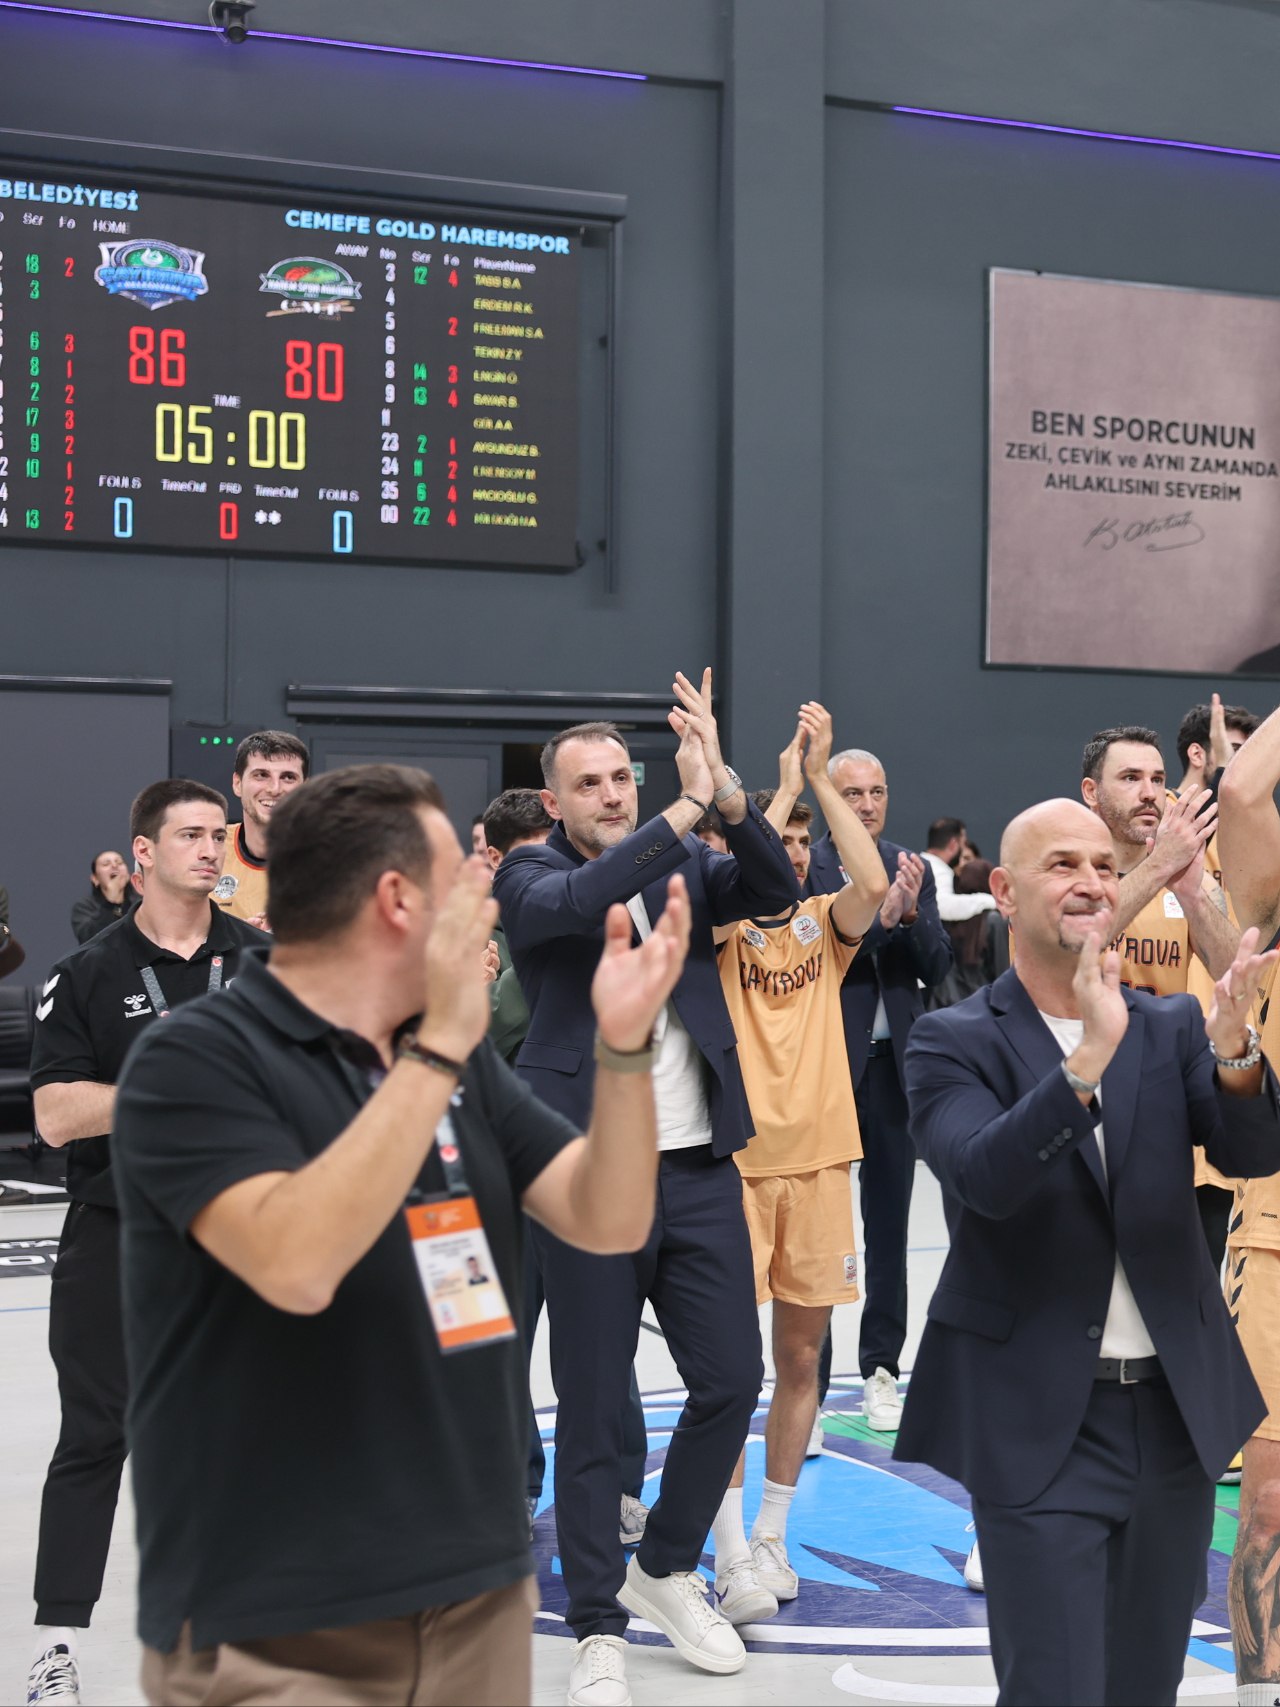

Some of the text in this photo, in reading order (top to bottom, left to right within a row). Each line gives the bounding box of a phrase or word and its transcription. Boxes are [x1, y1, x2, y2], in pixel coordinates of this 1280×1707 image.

[0, 179, 139, 212] BELEDİYESİ
[285, 209, 570, 255] CEMEFE GOLD HAREMSPOR
[26, 254, 40, 274] 18
[64, 257, 75, 277] 2
[414, 266, 428, 285] 12
[448, 269, 459, 288] 4
[30, 280, 40, 299] 3
[385, 287, 396, 306] 4
[385, 311, 396, 331] 5
[448, 317, 459, 336] 2
[30, 331, 40, 350] 6
[64, 334, 75, 353] 3
[385, 335, 396, 355] 6
[30, 356, 40, 376] 8
[129, 325, 187, 388] 86
[66, 360, 73, 379] 1
[285, 339, 345, 402] 80
[385, 360, 396, 379] 8
[414, 362, 427, 381] 14
[448, 365, 459, 384] 3
[31, 382, 40, 401] 2
[65, 384, 75, 404] 2
[213, 394, 241, 409] TIME
[385, 384, 396, 403] 9
[448, 389, 459, 408] 4
[26, 408, 40, 427] 17
[65, 410, 75, 430] 3
[155, 402, 307, 471] 05:00
[1031, 410, 1255, 450] BEN SPORCUNUN
[30, 433, 40, 452] 9
[65, 435, 75, 455] 2
[381, 432, 399, 452] 23
[417, 434, 427, 454] 2
[449, 437, 457, 455] 1
[26, 458, 40, 478] 10
[381, 456, 399, 476] 34
[448, 460, 458, 480] 2
[1005, 442, 1279, 478] ZEKİ, ÇEVİK ve AYNI ZAMANDA
[66, 461, 73, 480] 1
[64, 485, 75, 505] 2
[161, 478, 207, 494] TimeOut
[254, 484, 300, 500] TimeOut
[381, 480, 399, 500] 35
[417, 482, 427, 502] 6
[447, 485, 458, 504] 4
[1045, 473, 1242, 502] AHLAKLISINI SEVERİM
[26, 509, 40, 529] 13
[64, 511, 75, 531] 2
[114, 496, 133, 539] 0
[220, 502, 239, 541] 0
[380, 504, 399, 524] 00
[413, 506, 431, 526] 22
[447, 509, 458, 528] 4
[333, 509, 354, 554] 0
